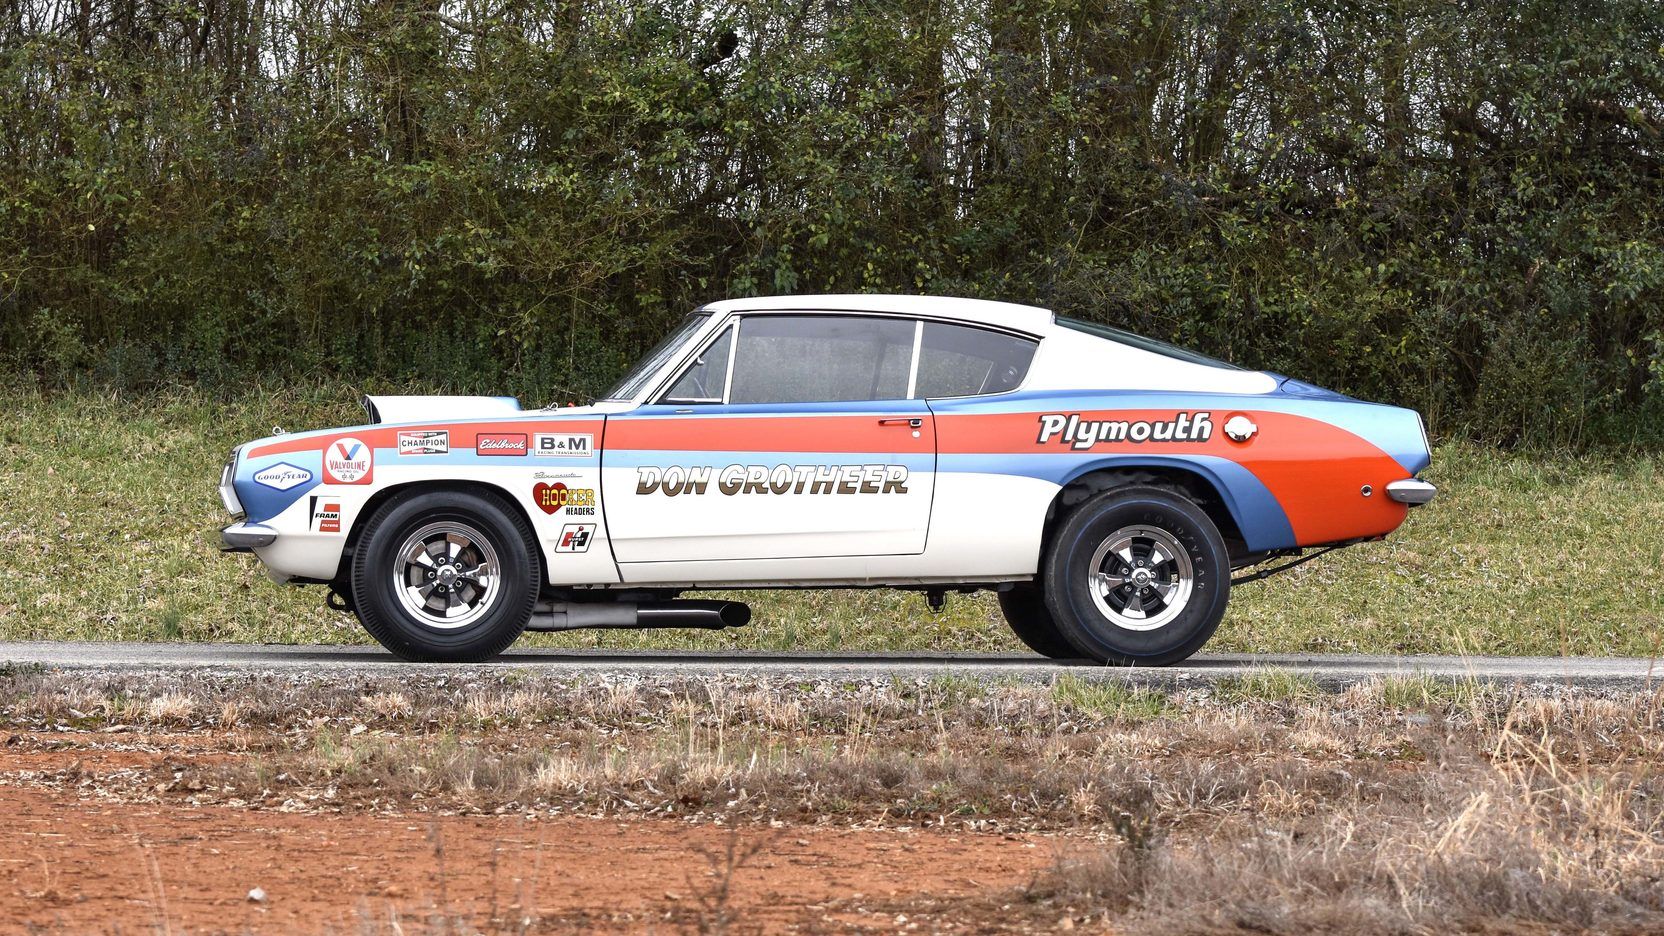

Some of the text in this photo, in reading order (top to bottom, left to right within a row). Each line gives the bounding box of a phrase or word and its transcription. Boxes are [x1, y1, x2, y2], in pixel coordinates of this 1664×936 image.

[1036, 412, 1213, 450] Plymouth
[401, 439, 446, 447] CHAMPION
[480, 438, 526, 450] Edelbrock
[329, 460, 366, 472] VALVOLINE
[635, 463, 909, 496] DON GROTHEER
[541, 488, 596, 507] HOOKER
[565, 507, 595, 516] HEADERS
